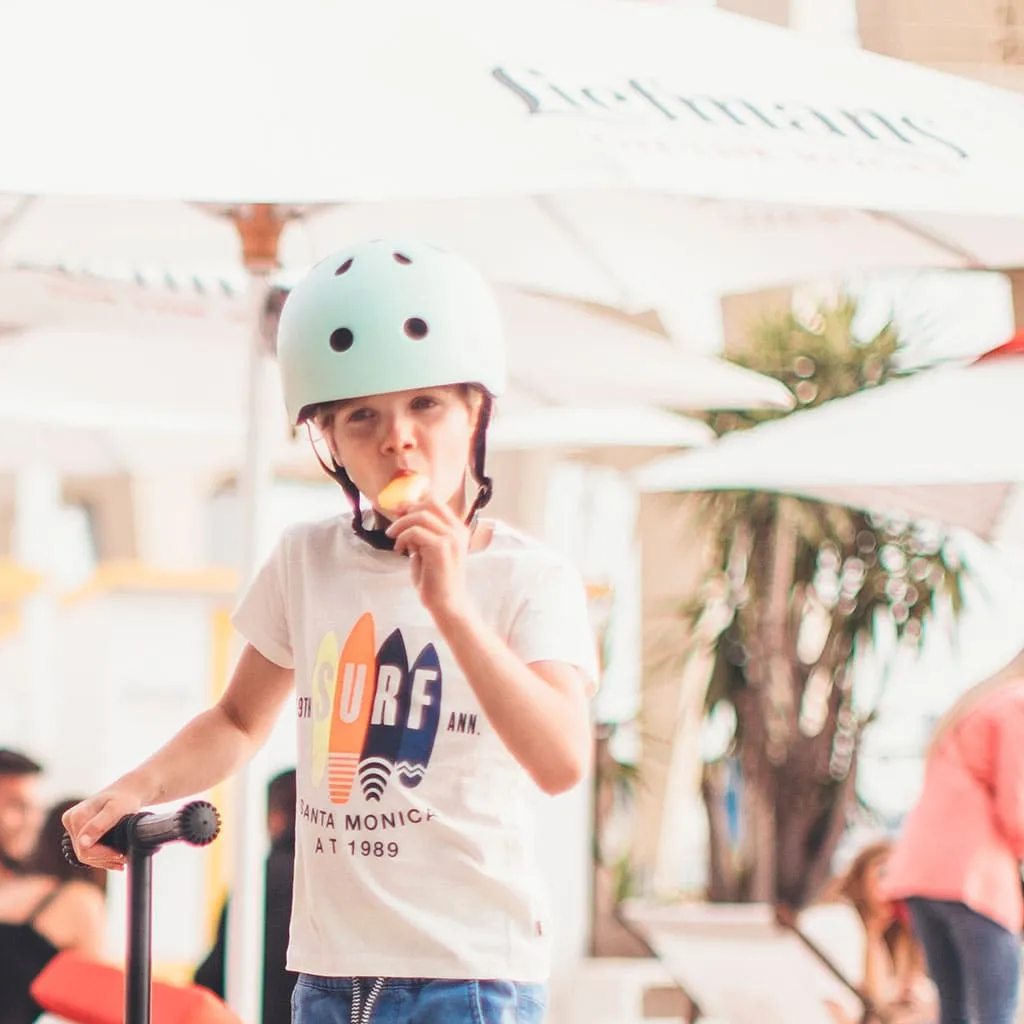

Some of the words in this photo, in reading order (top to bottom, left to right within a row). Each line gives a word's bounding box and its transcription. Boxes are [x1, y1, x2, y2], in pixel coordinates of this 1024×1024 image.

[314, 660, 439, 731] SURF
[447, 711, 481, 736] ANN.
[300, 798, 335, 830] SANTA
[314, 838, 337, 854] AT
[347, 840, 399, 857] 1989
